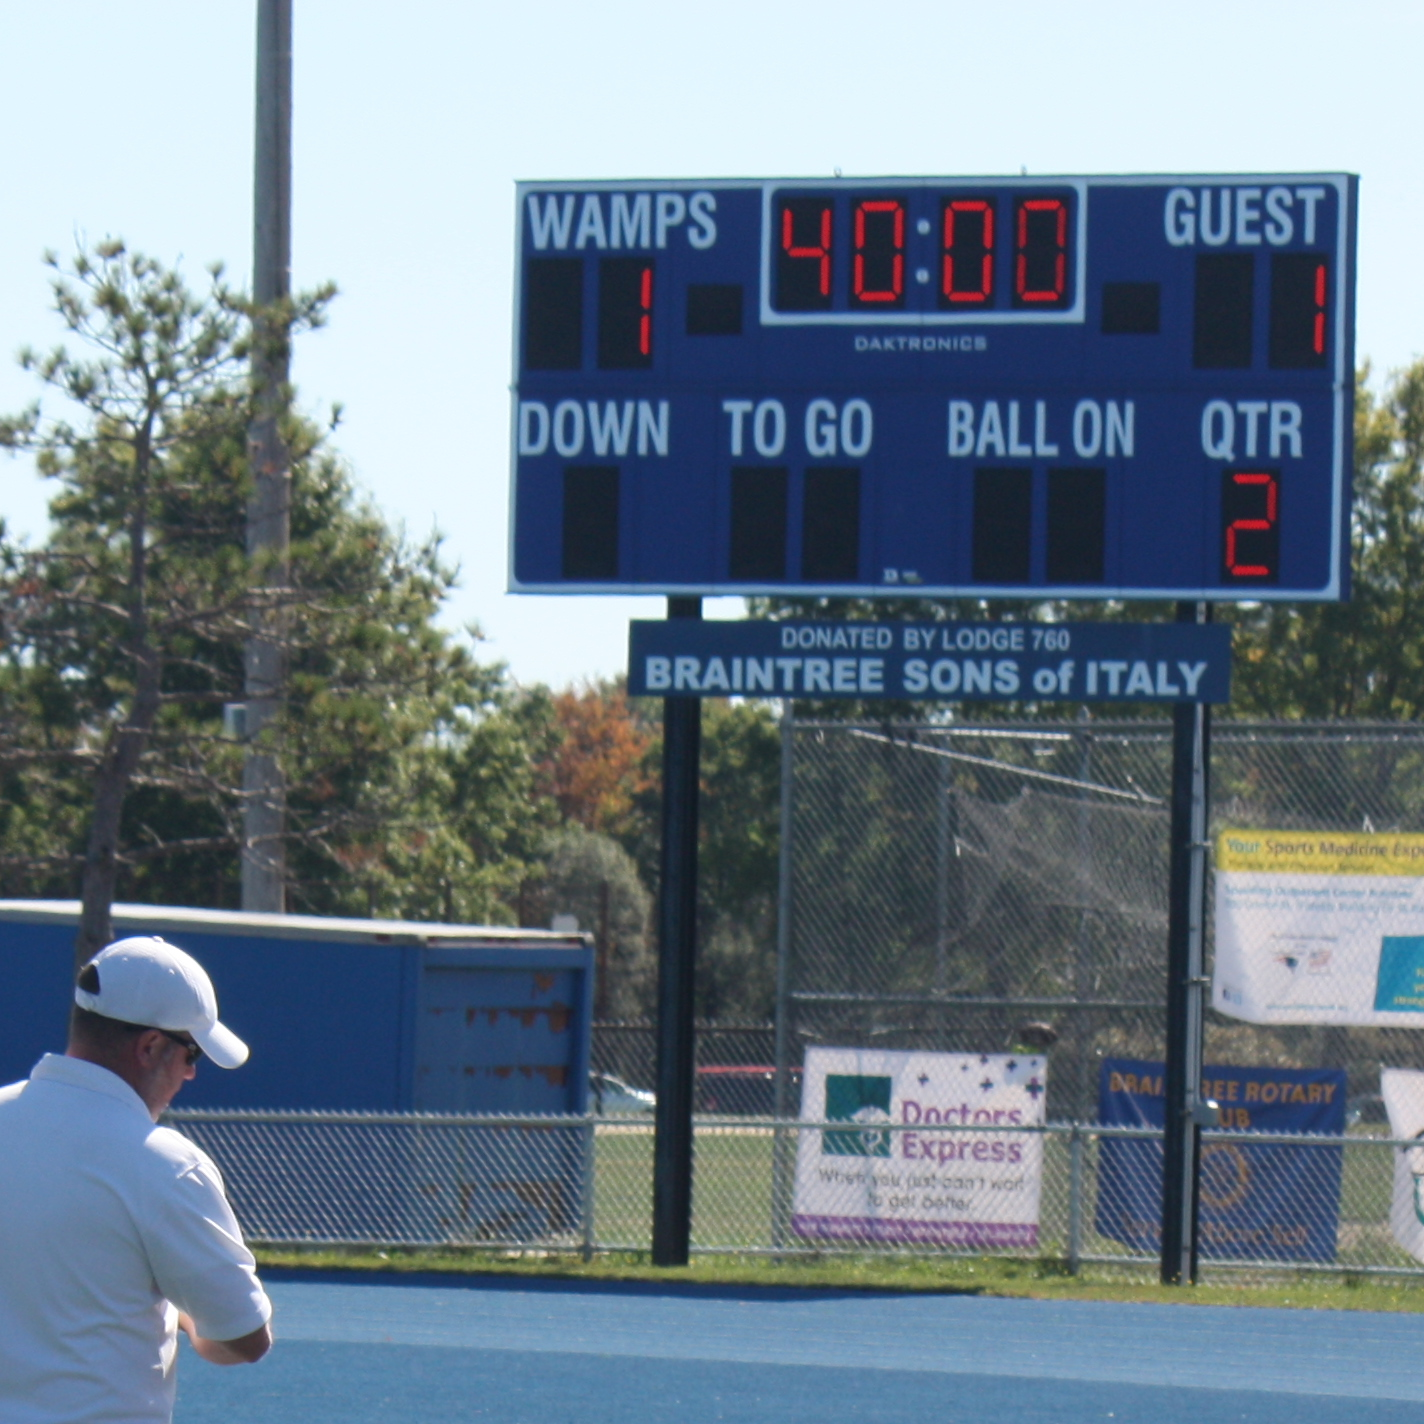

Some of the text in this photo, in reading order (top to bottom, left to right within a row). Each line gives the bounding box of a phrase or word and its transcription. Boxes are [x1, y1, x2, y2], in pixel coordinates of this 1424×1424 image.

[529, 193, 717, 250] WAMPS
[1164, 188, 1326, 246] GUEST
[782, 199, 1067, 302] 40:00
[638, 268, 653, 355] 1
[1312, 264, 1326, 354] 1
[855, 335, 987, 352] DAKTRONICS
[519, 402, 669, 457] DOWN
[723, 399, 873, 457] TO GO
[948, 400, 1135, 457] BALL ON
[1201, 400, 1303, 462] QTR
[1226, 473, 1278, 577] 2
[781, 626, 1072, 652] DONATED BY LODGE 760
[645, 656, 1207, 696] BRAINTREE SONS of ITALY
[1227, 838, 1261, 855] Your
[1265, 839, 1315, 859] Sports
[1319, 841, 1387, 858] Medicine
[902, 1100, 1023, 1124] Doctors
[1109, 1071, 1337, 1104] BRAIREE ROTARY
[902, 1133, 1023, 1166] Express
